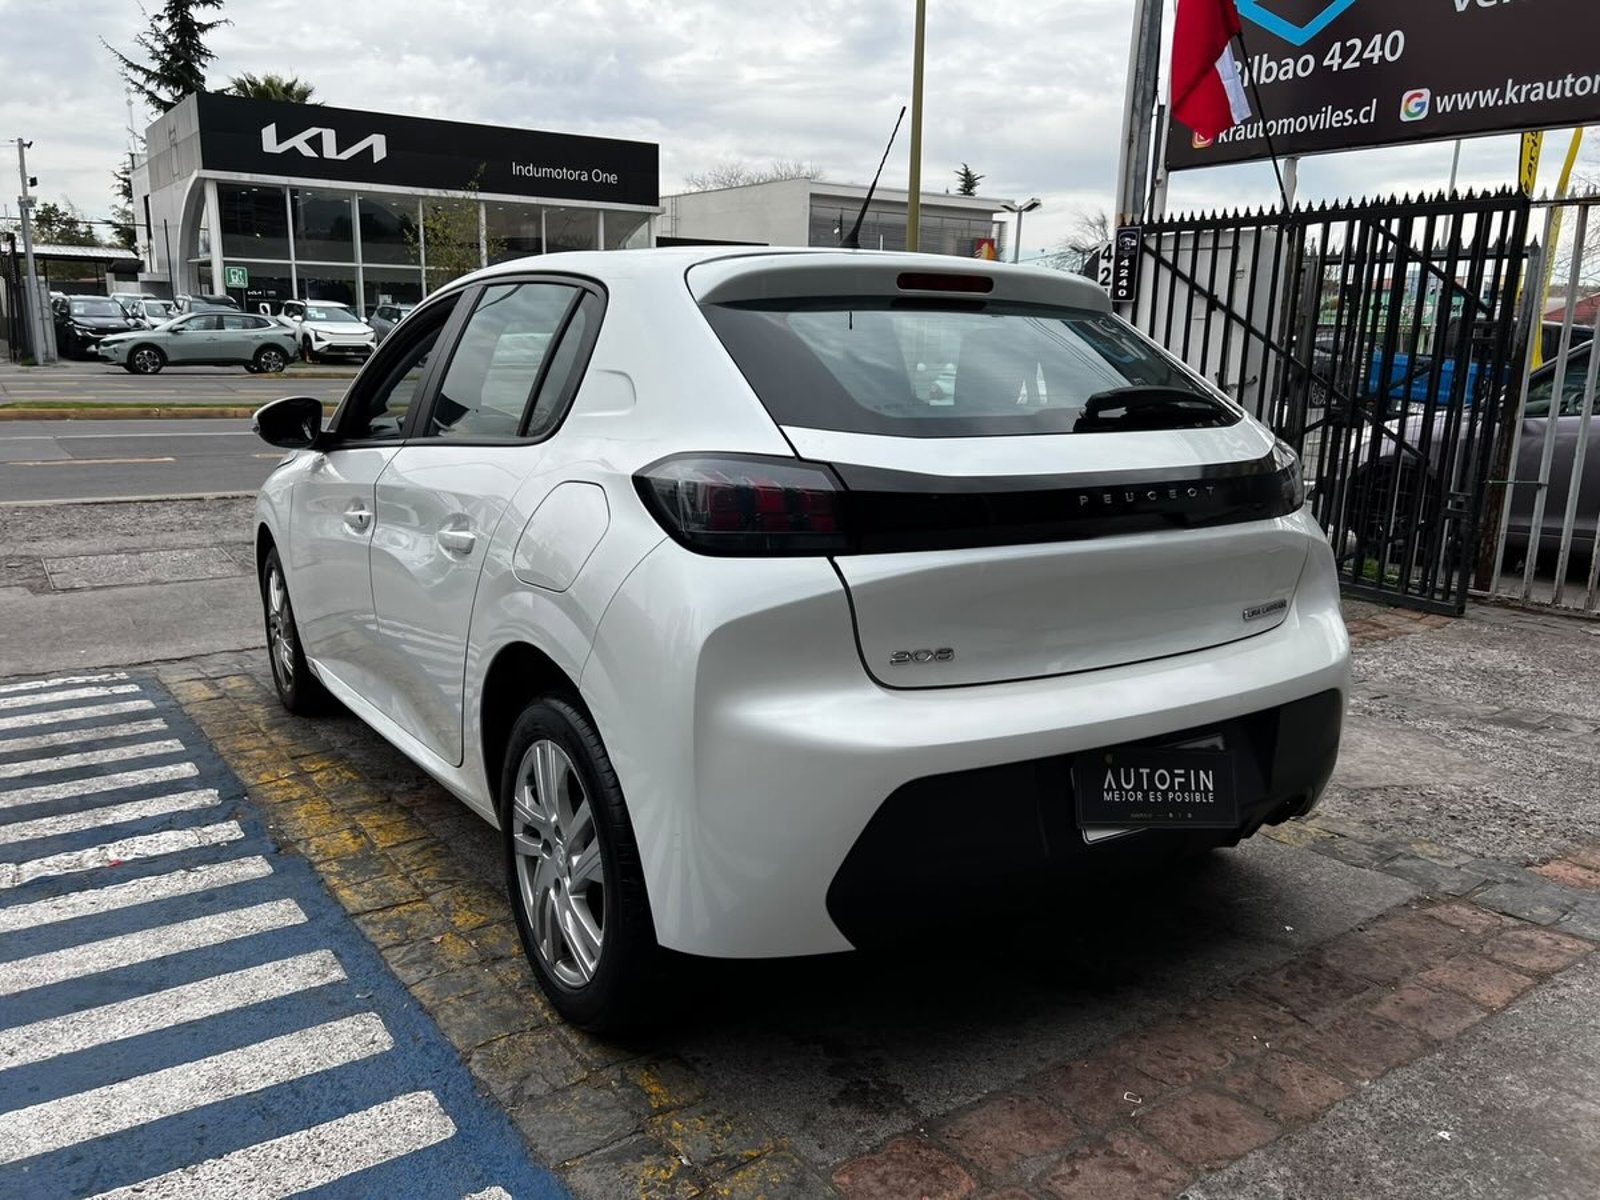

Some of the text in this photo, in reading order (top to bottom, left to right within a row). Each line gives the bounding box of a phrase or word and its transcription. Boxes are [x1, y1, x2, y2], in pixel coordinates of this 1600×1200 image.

[1322, 29, 1405, 72] 4240
[1217, 98, 1378, 144] krautomoviles.cl
[261, 122, 387, 164] KIA
[512, 161, 619, 185] Indumotora One
[1099, 243, 1114, 290] 42
[1118, 258, 1130, 297] 4240
[1079, 485, 1215, 507] PEUGEOT
[889, 647, 956, 666] 208
[1103, 767, 1214, 791] AUTOFIN
[1103, 790, 1215, 803] MEJOR ES POSIBLE
